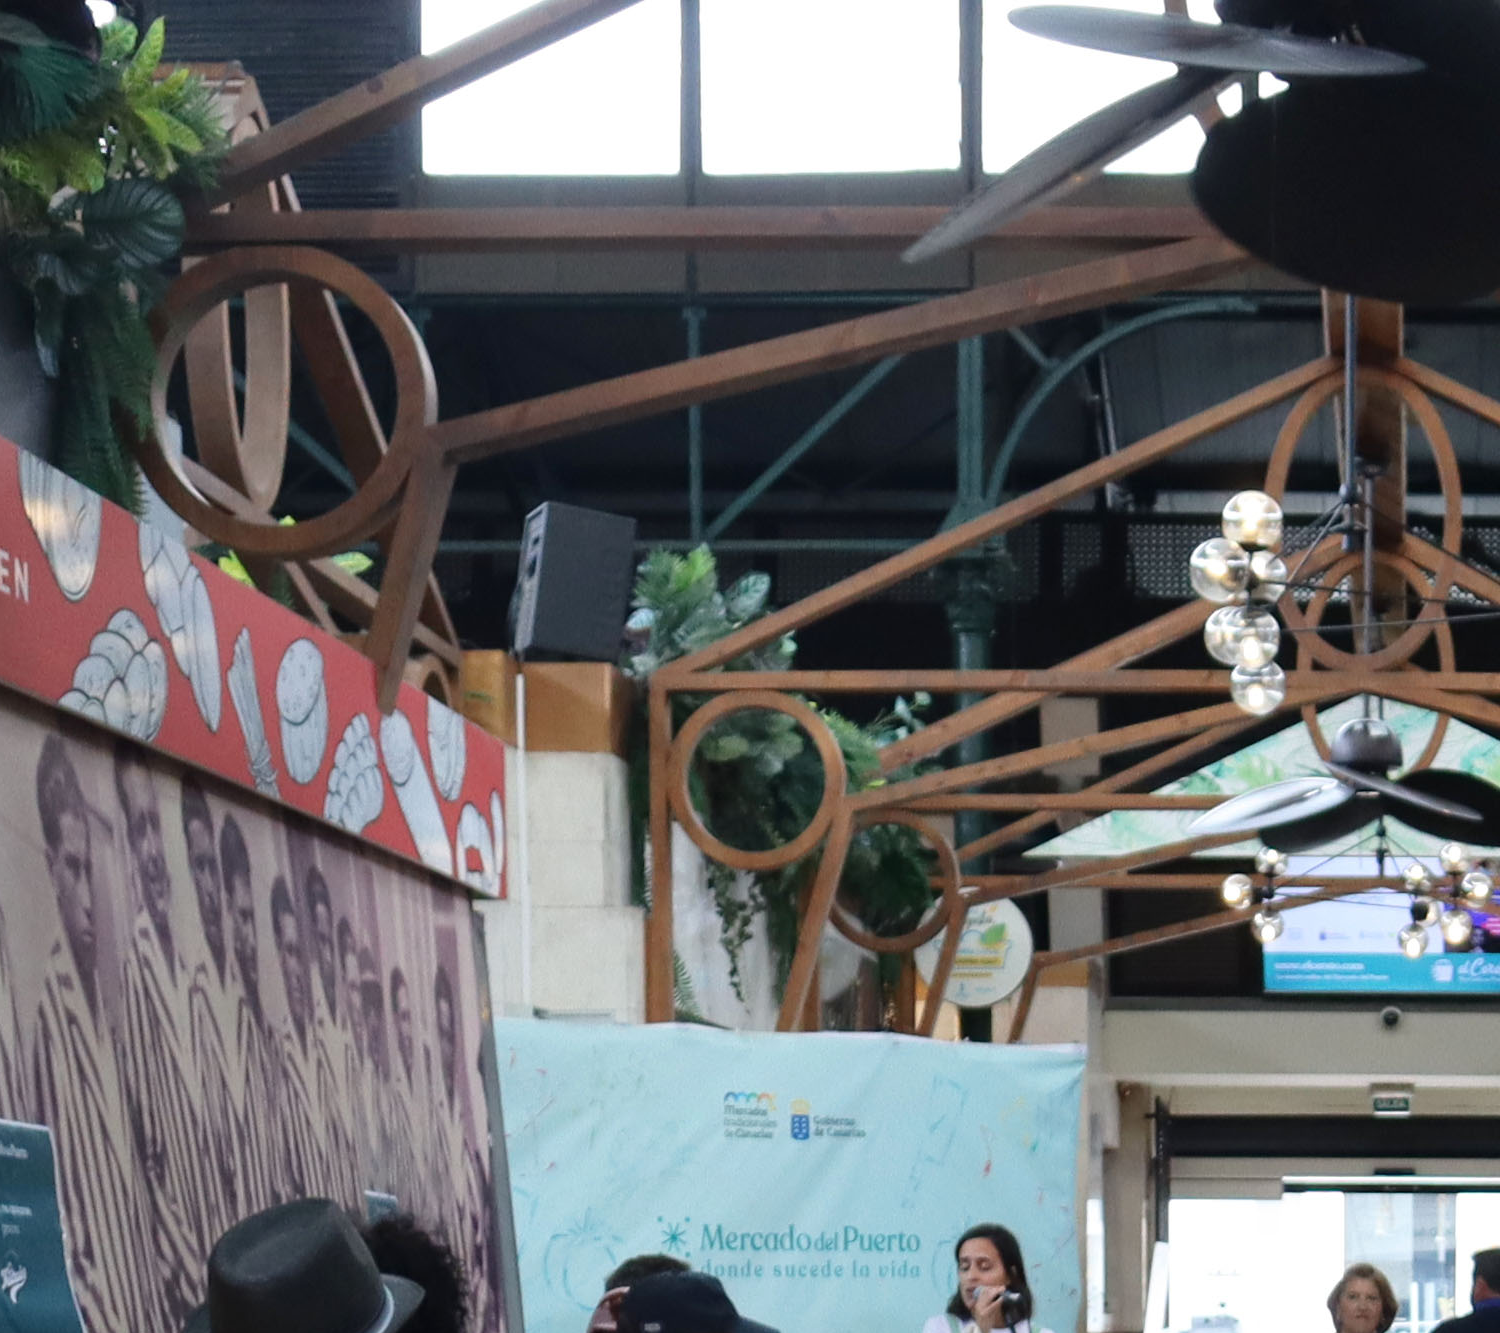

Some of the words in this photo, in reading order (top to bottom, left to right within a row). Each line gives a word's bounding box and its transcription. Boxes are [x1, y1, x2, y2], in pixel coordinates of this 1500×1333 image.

[700, 1224, 812, 1251] Mercado
[814, 1231, 838, 1251] del
[843, 1225, 921, 1252] Puerto
[701, 1259, 764, 1278] donde
[773, 1259, 844, 1278] sucede
[852, 1259, 870, 1278] la
[878, 1259, 921, 1278] vida
